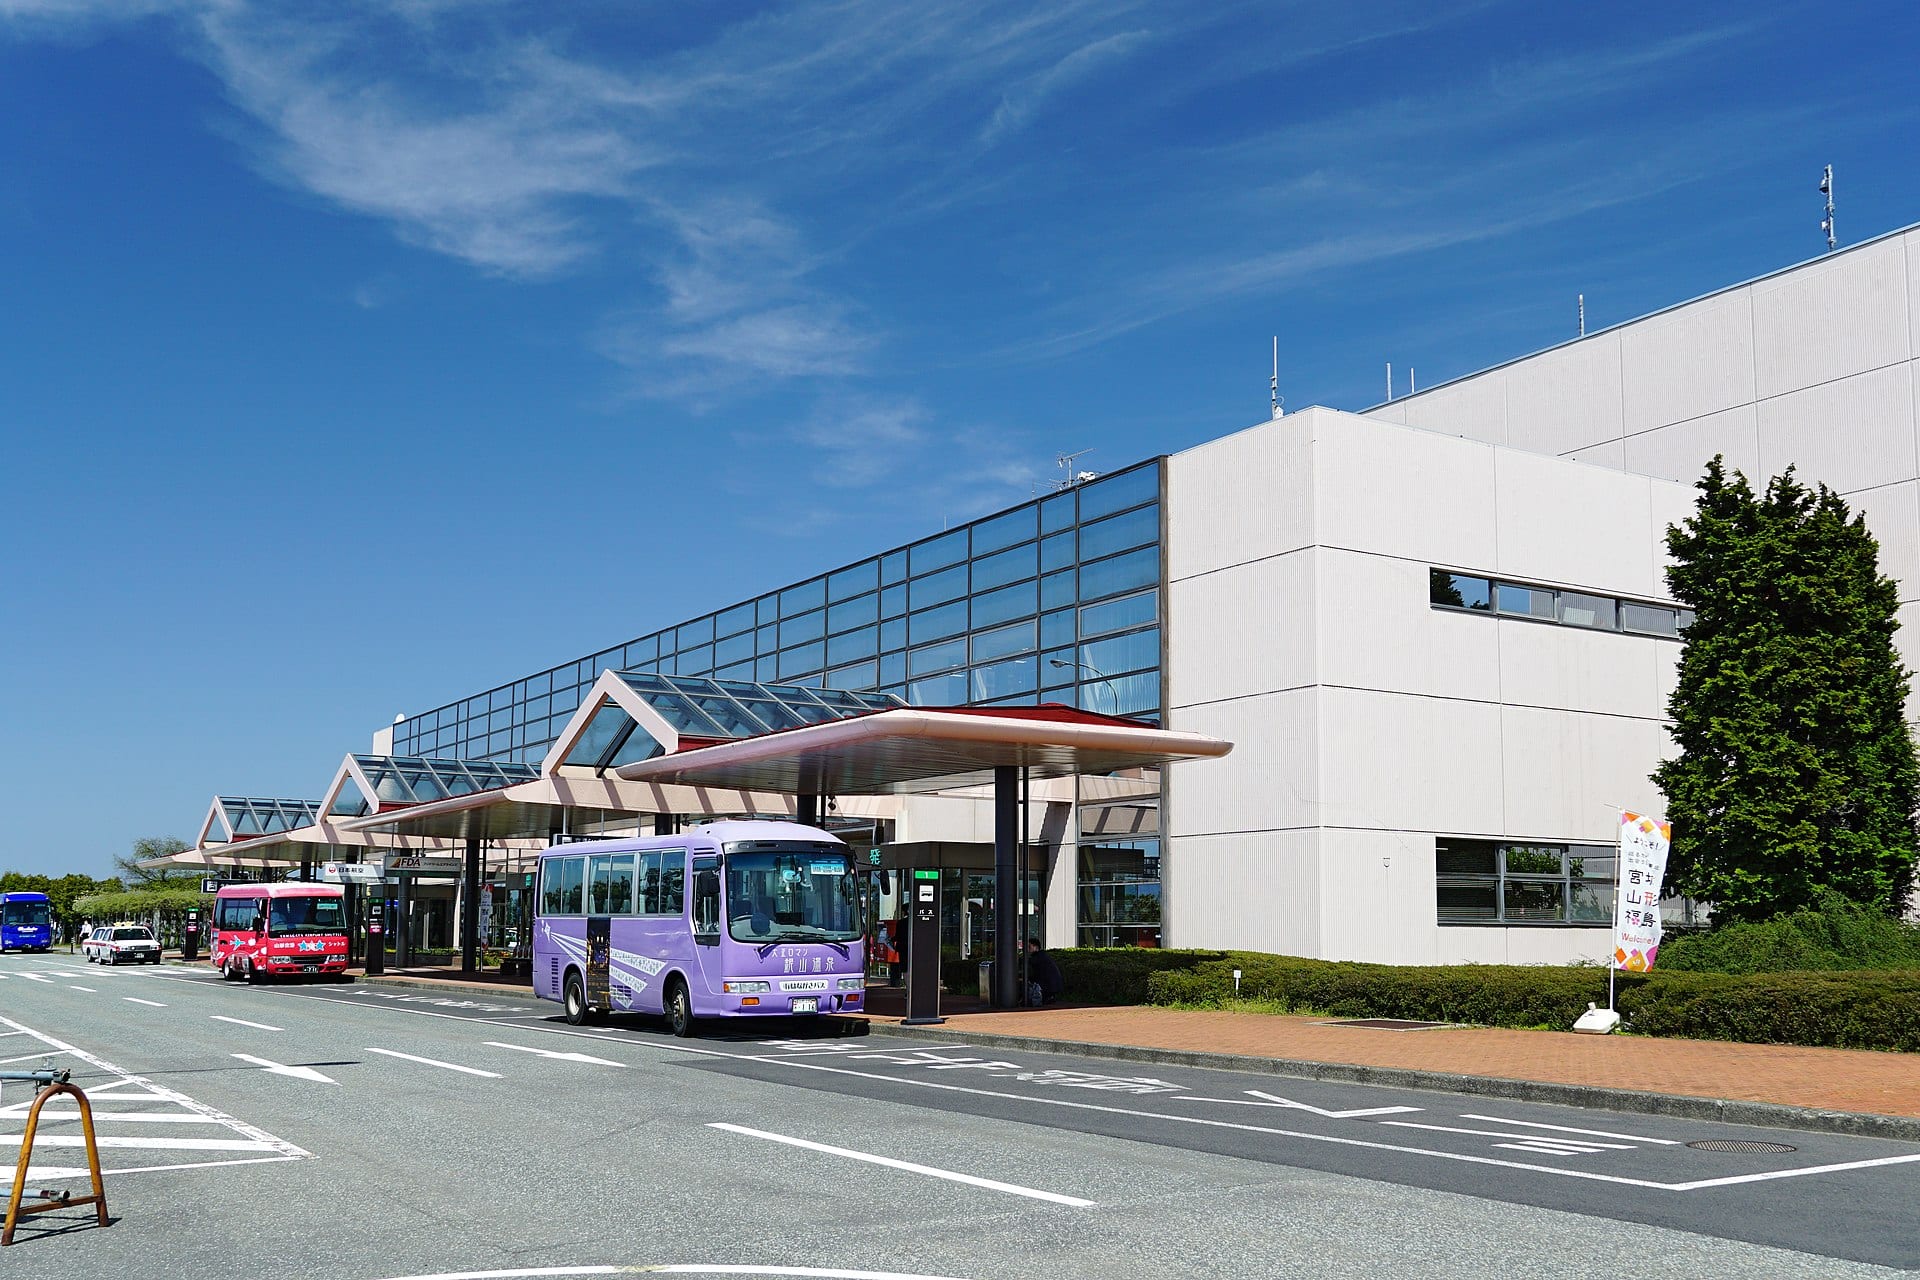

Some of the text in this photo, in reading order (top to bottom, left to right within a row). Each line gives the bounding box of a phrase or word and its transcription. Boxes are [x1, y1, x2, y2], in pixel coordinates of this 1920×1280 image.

[401, 857, 421, 866] FDA
[1626, 889, 1659, 907] 山形
[1625, 909, 1657, 928] 福島
[783, 956, 834, 973] 銀山温泉
